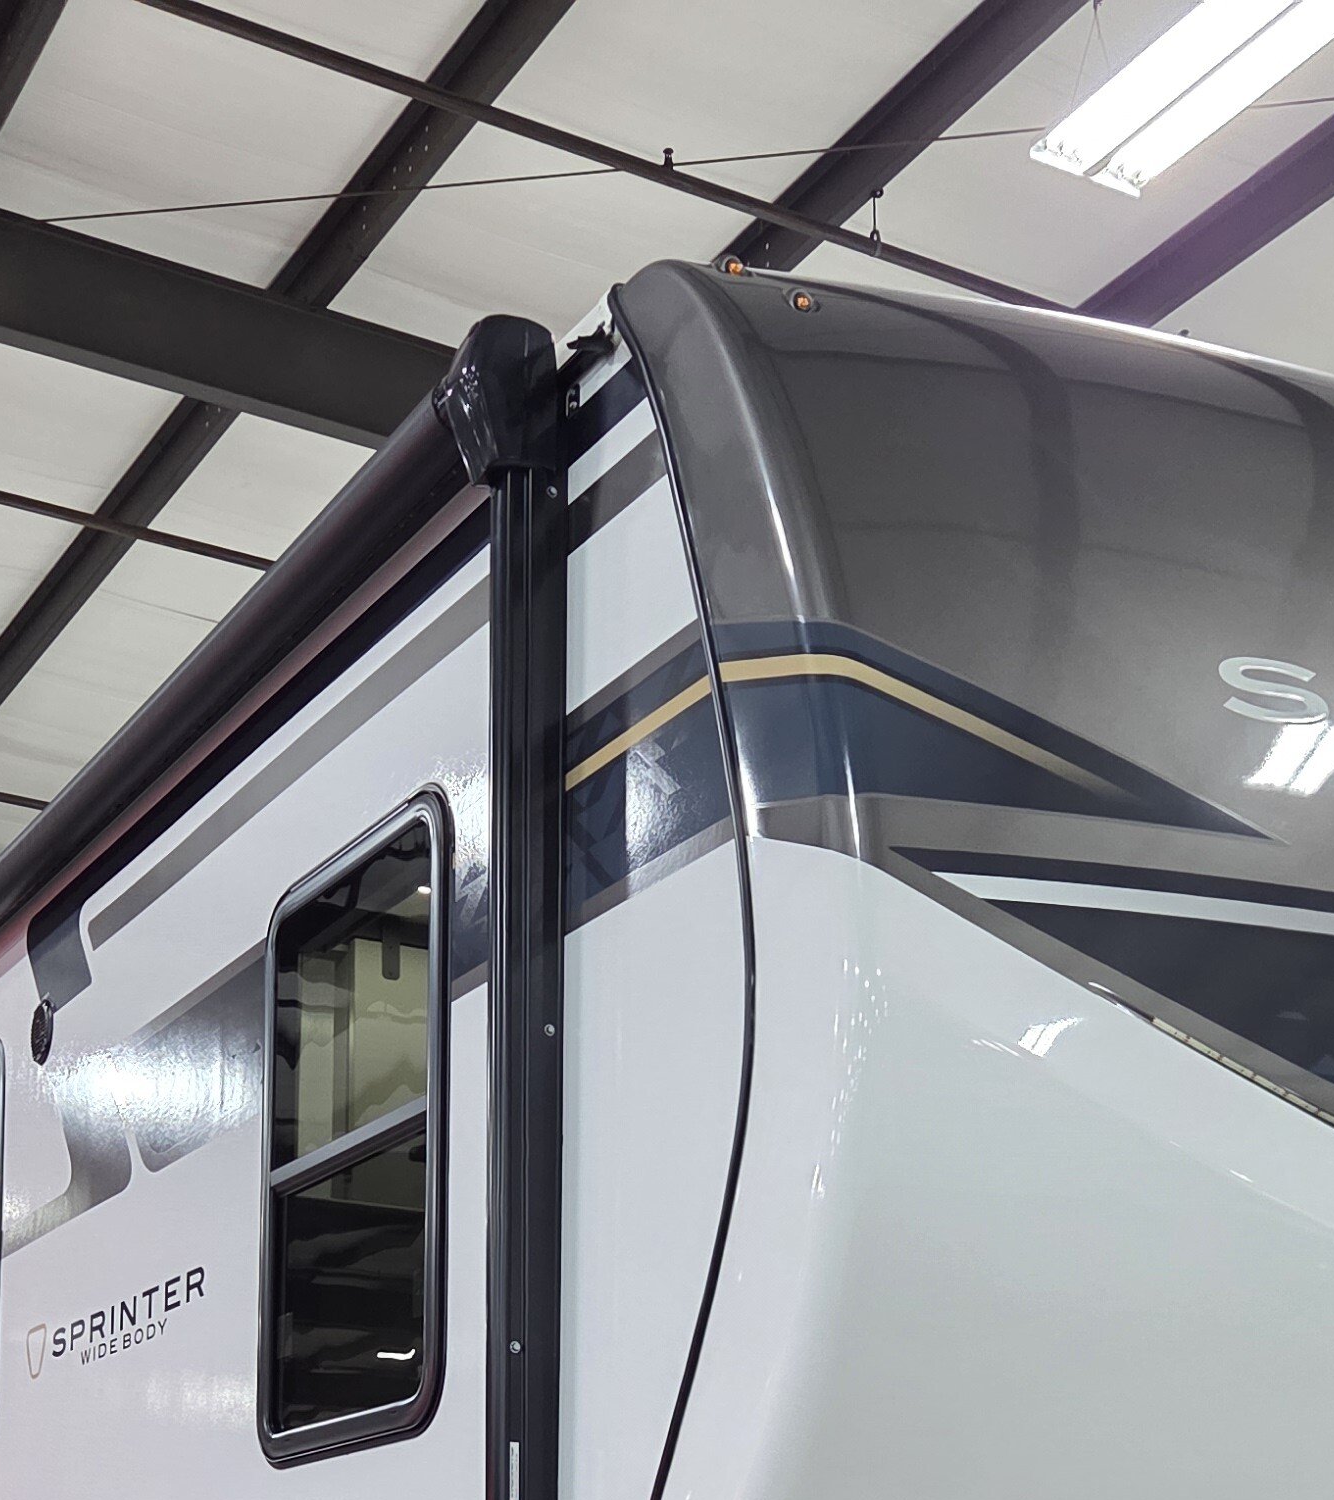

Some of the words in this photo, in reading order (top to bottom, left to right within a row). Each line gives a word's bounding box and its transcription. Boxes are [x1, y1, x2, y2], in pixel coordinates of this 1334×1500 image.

[52, 1266, 205, 1358] SPRINTER
[81, 1338, 118, 1365] WIDE
[122, 1318, 167, 1350] BODY
